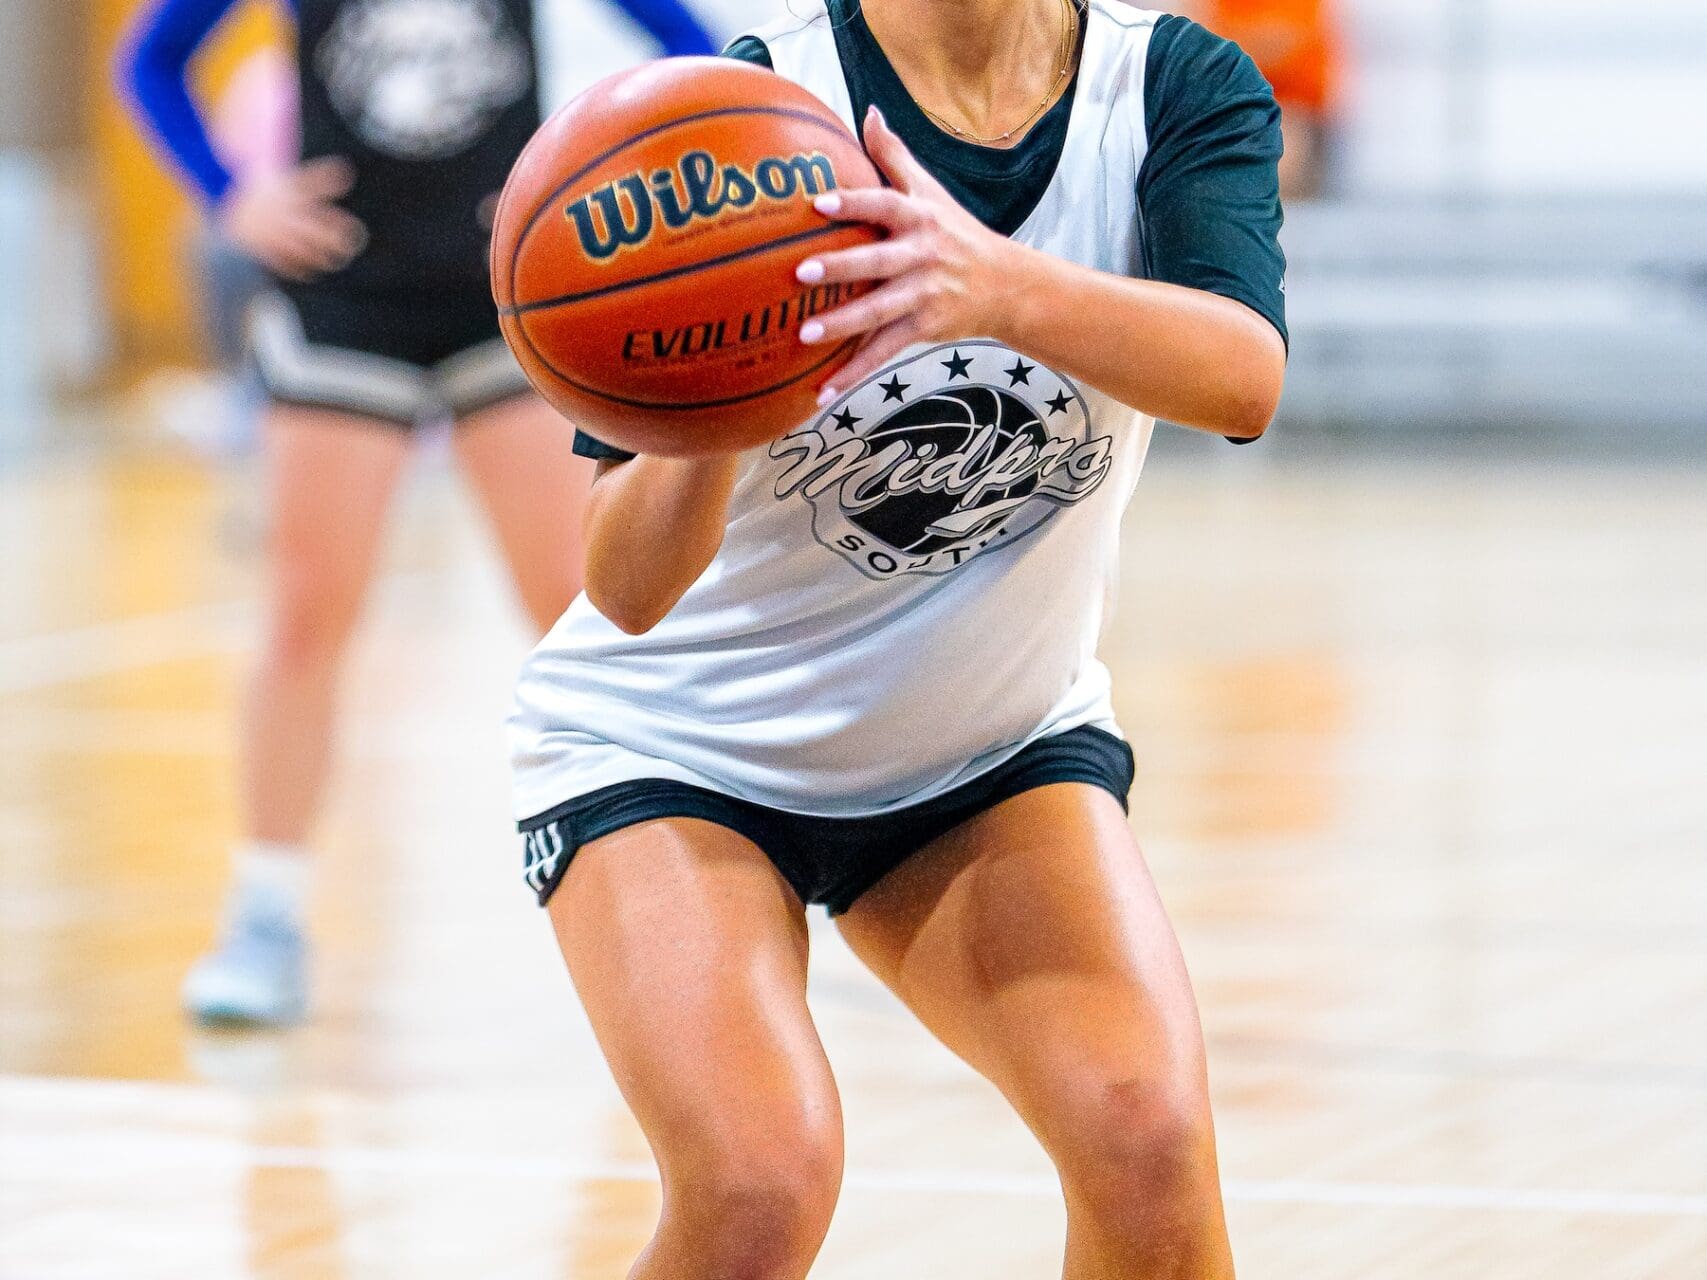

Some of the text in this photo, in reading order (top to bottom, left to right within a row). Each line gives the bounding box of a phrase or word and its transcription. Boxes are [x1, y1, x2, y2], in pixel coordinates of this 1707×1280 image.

[563, 148, 838, 266] Wilson
[768, 423, 1113, 518] Midpro
[836, 527, 1009, 574] SOUT
